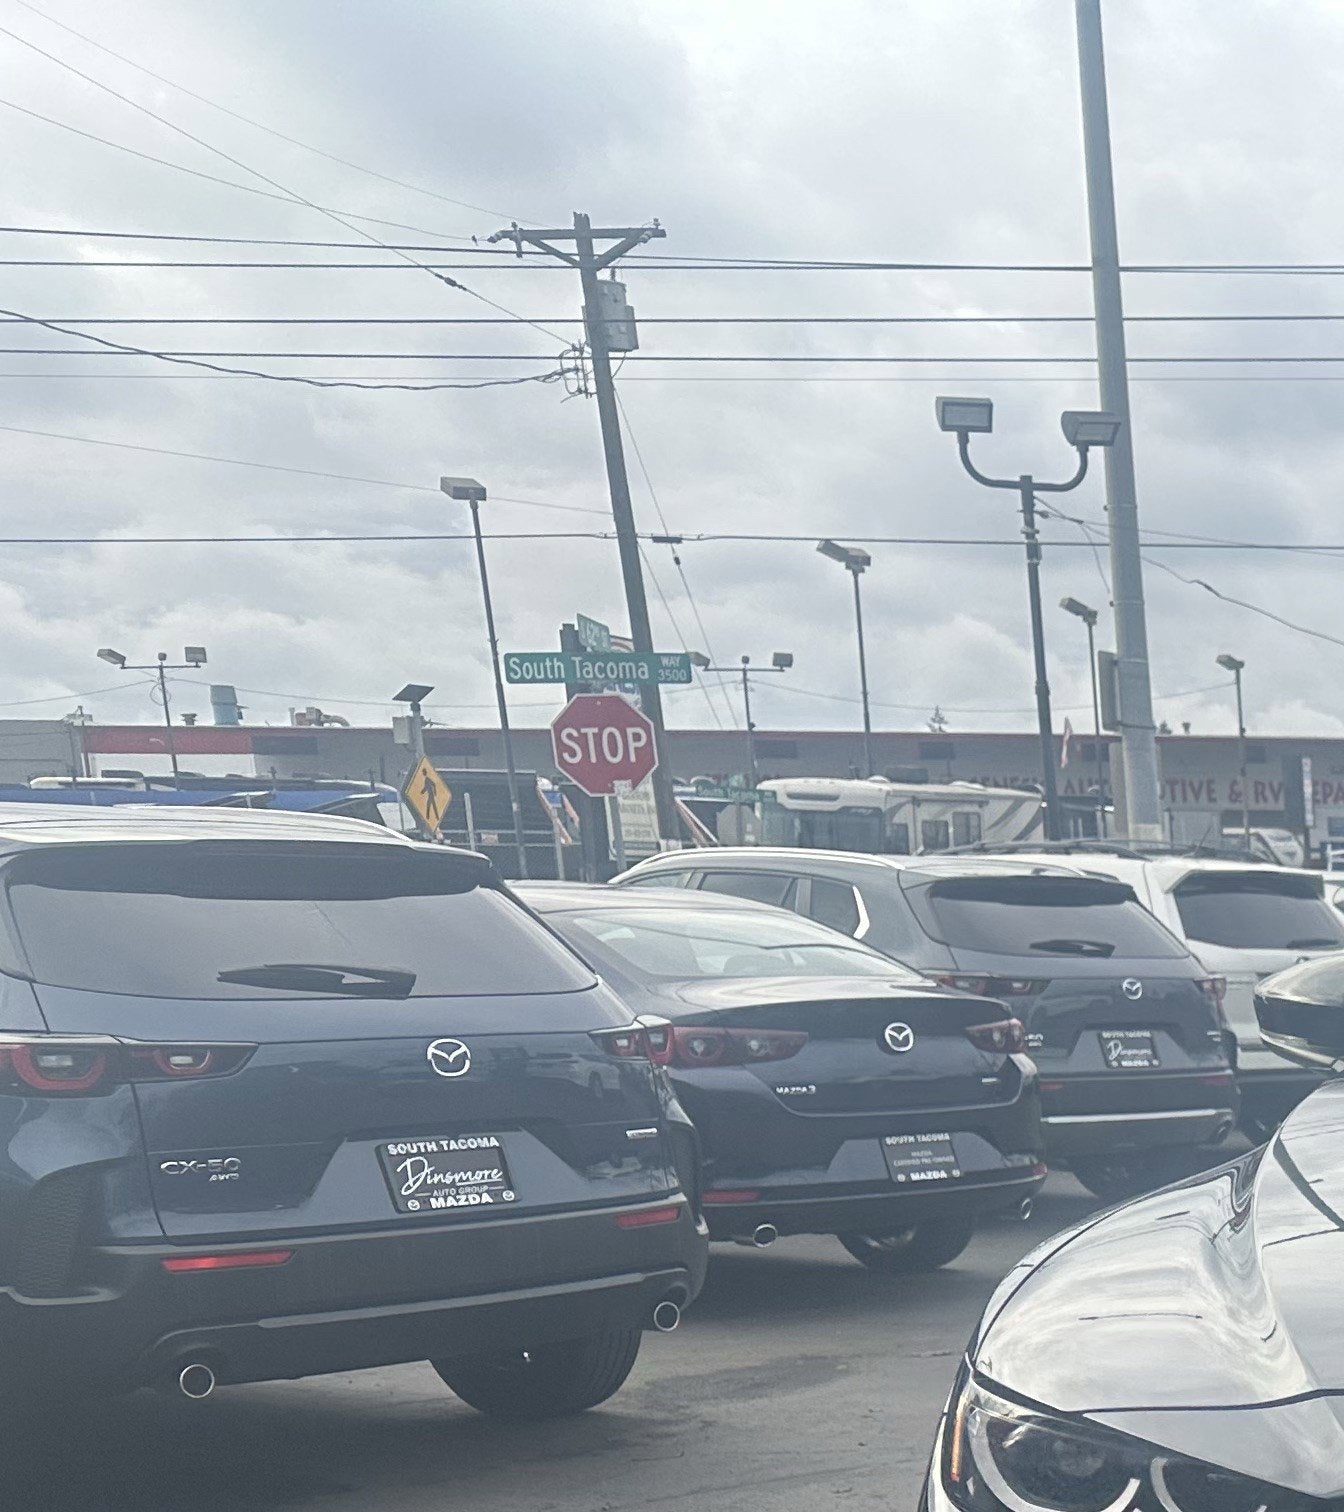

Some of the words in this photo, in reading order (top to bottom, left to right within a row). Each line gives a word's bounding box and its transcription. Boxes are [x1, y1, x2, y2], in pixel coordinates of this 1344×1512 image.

[509, 657, 566, 680] South
[571, 656, 649, 680] Tacoma
[659, 656, 681, 668] WAY
[658, 668, 687, 682] 3500
[560, 726, 648, 764] STOP
[1254, 780, 1284, 803] RV
[387, 1141, 438, 1155] SOUTH
[439, 1136, 500, 1151] TACOMA
[160, 1157, 241, 1174] CX-50
[396, 1156, 503, 1195] Dinsmore
[910, 1170, 948, 1181] MAZDA
[429, 1192, 494, 1208] MAZDA
[432, 1187, 456, 1197] AUTO
[458, 1185, 489, 1195] GROUP
